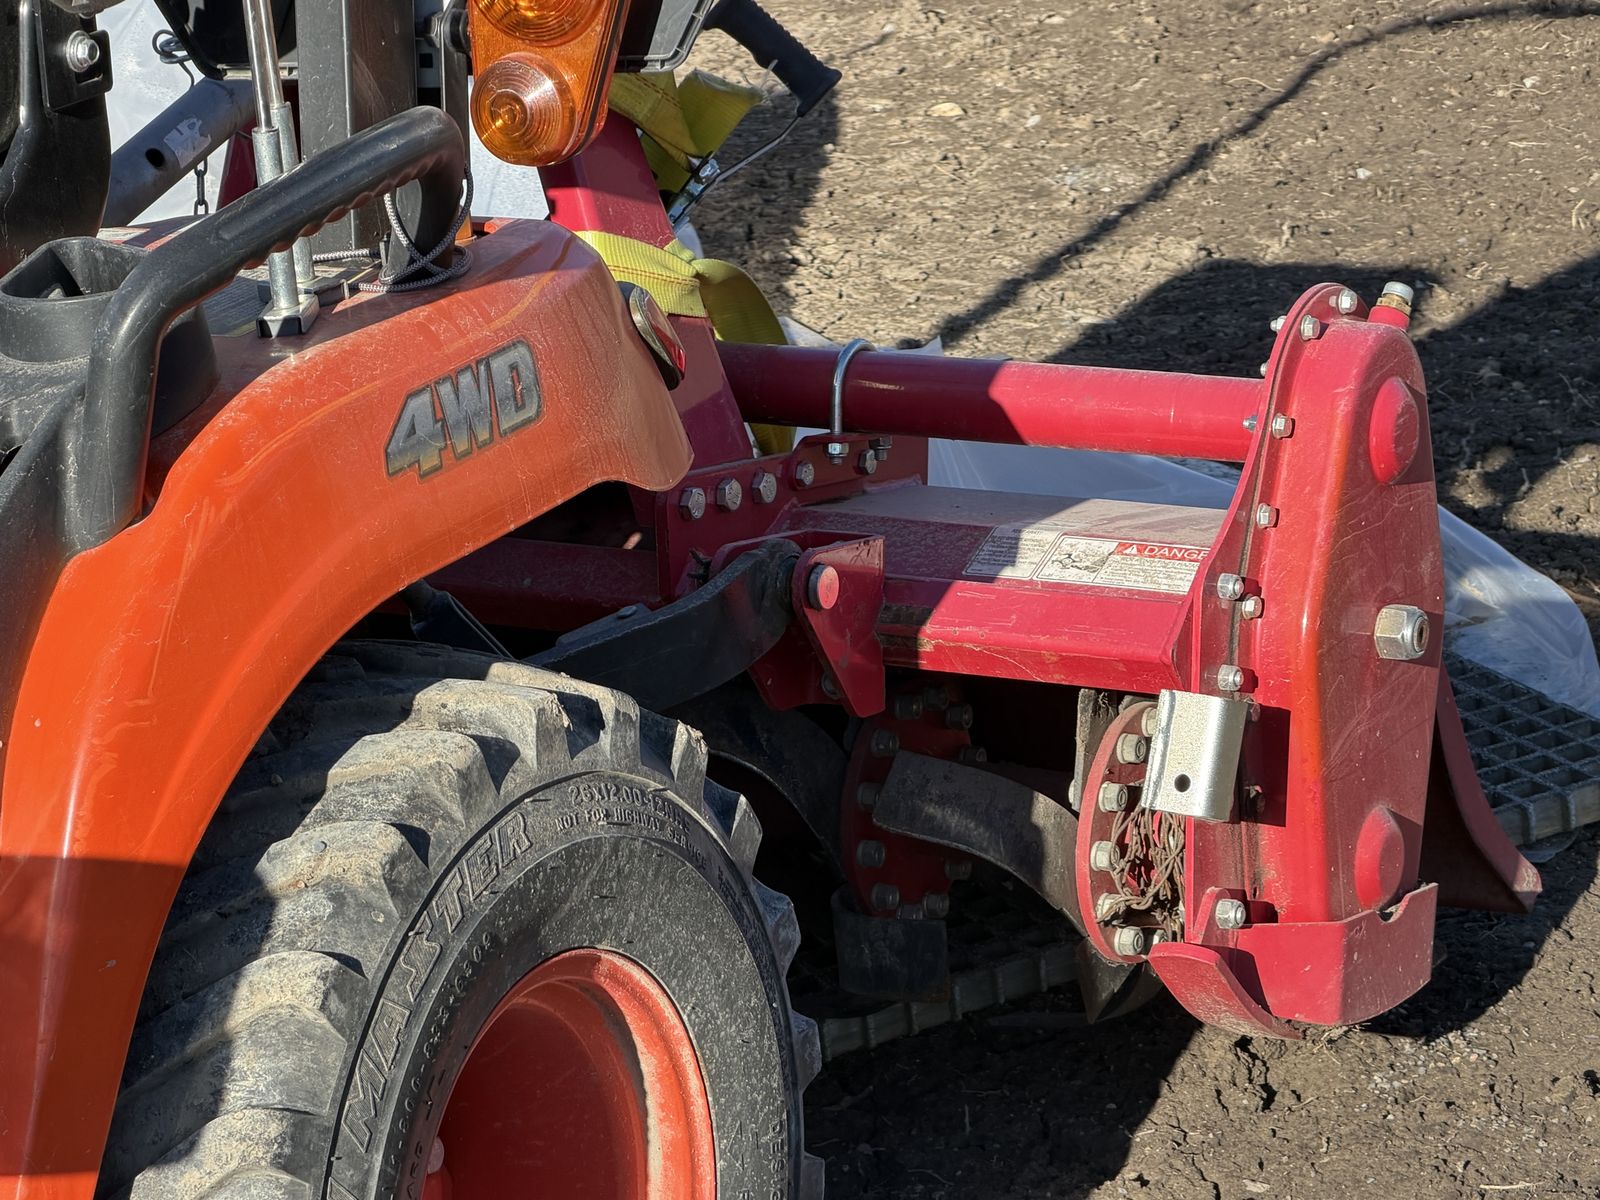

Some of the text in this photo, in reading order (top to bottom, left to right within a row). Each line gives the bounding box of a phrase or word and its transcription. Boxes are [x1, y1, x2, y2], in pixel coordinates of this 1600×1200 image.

[385, 339, 542, 480] 4WD
[1144, 545, 1209, 560] DANGE
[554, 815, 579, 832] NOT
[585, 807, 608, 823] FOR
[614, 806, 662, 832] HIGHWAY
[342, 810, 534, 1155] MASTER
